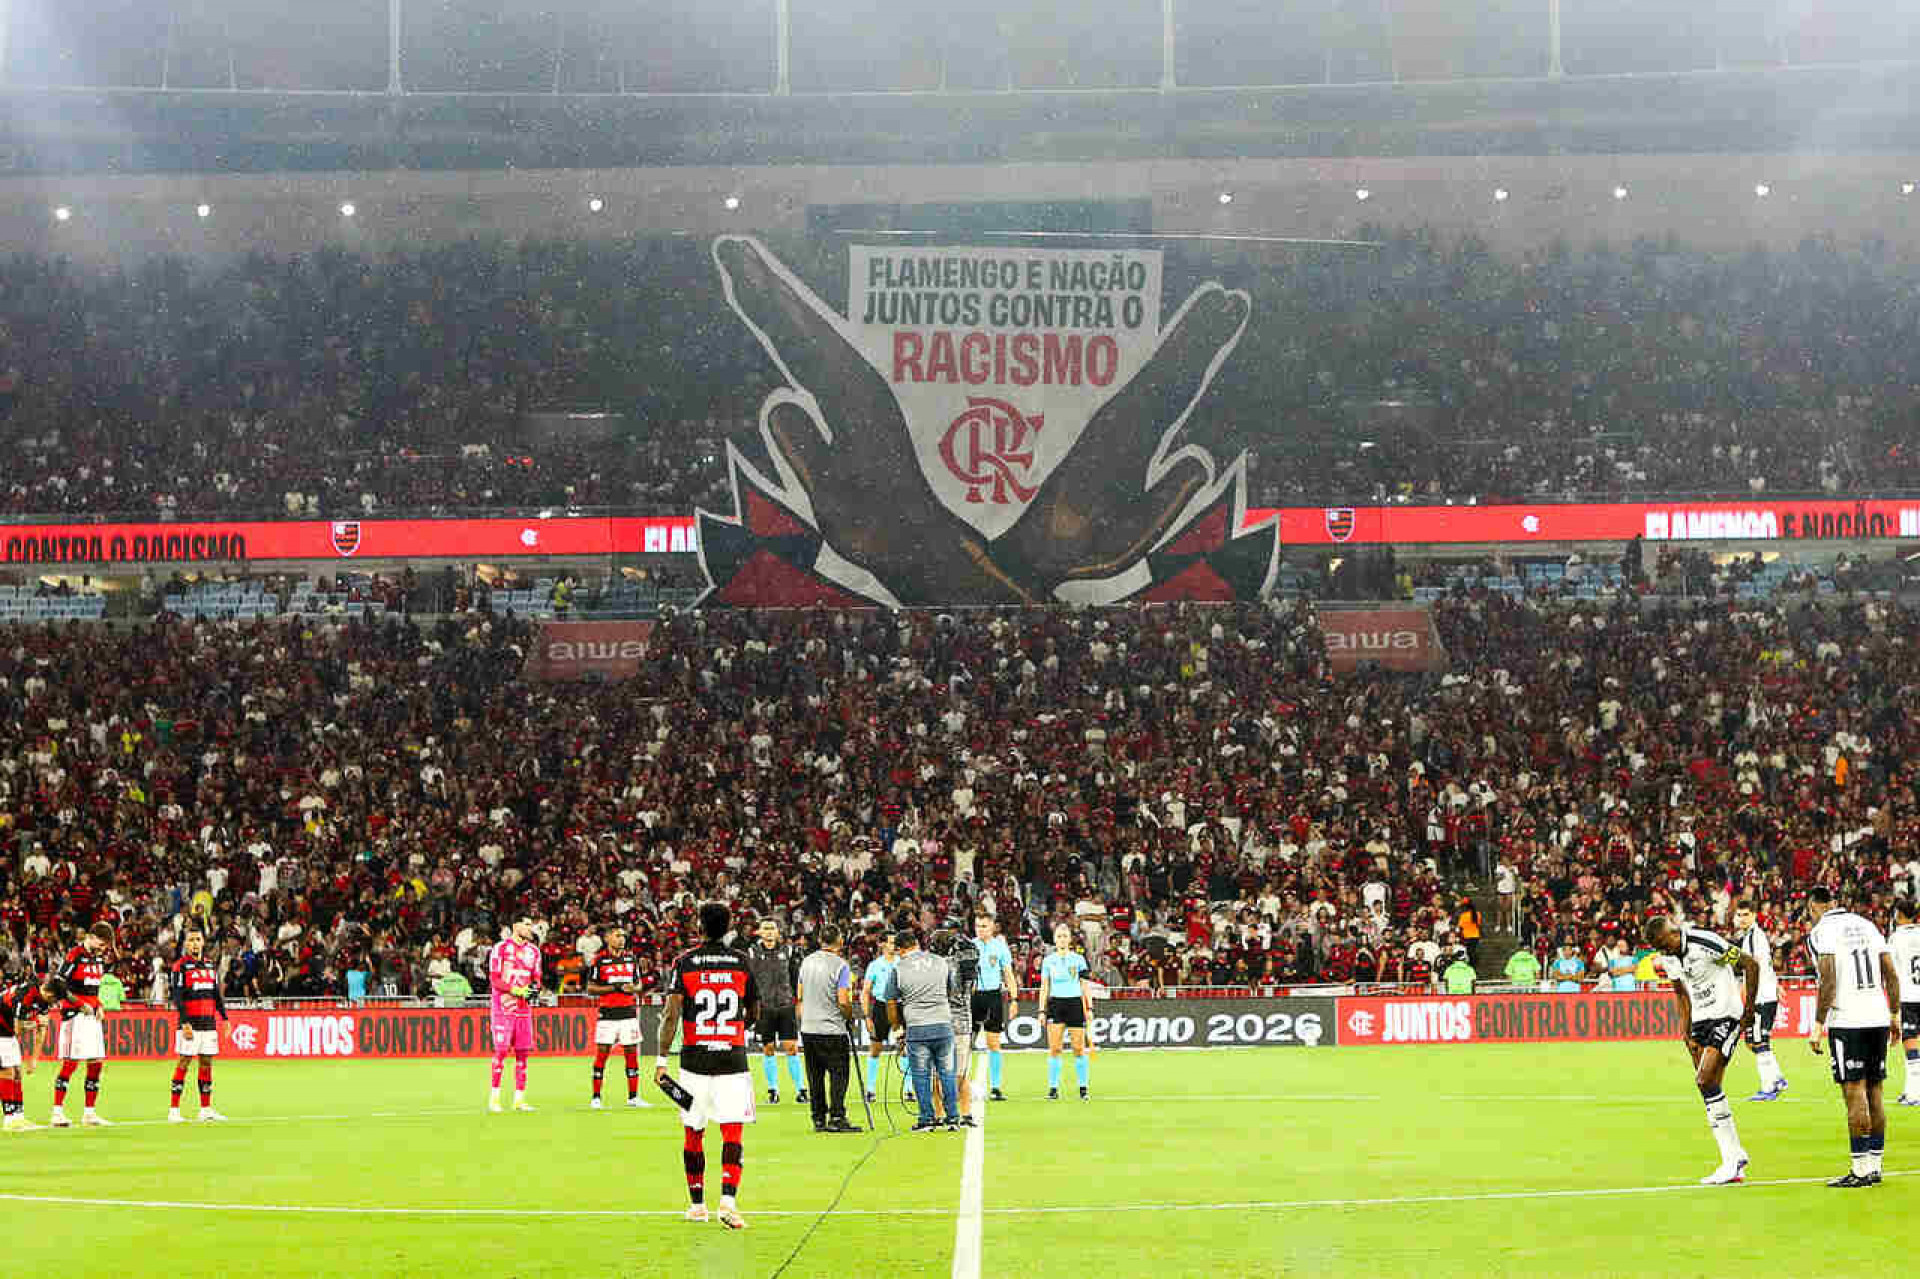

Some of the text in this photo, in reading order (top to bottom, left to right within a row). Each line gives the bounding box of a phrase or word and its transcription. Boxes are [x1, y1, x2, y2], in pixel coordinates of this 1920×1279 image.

[868, 253, 1147, 292] FLAMENGO E NAÇÃO
[864, 290, 1144, 328] JUNTOS CONTRA O
[893, 330, 1120, 387] RACISMO
[549, 640, 649, 659] aiwa
[1322, 632, 1419, 649] aiwa
[1852, 949, 1876, 989] 11
[695, 988, 739, 1036] 22
[1208, 1013, 1323, 1043] 2026
[1382, 1002, 1472, 1041] JUNTOS
[1476, 1000, 1570, 1038] CONTRA
[1575, 1000, 1590, 1037] O
[264, 1015, 355, 1056] JUNTOS
[359, 1015, 453, 1053] CONTRA
[458, 1015, 475, 1053] O
